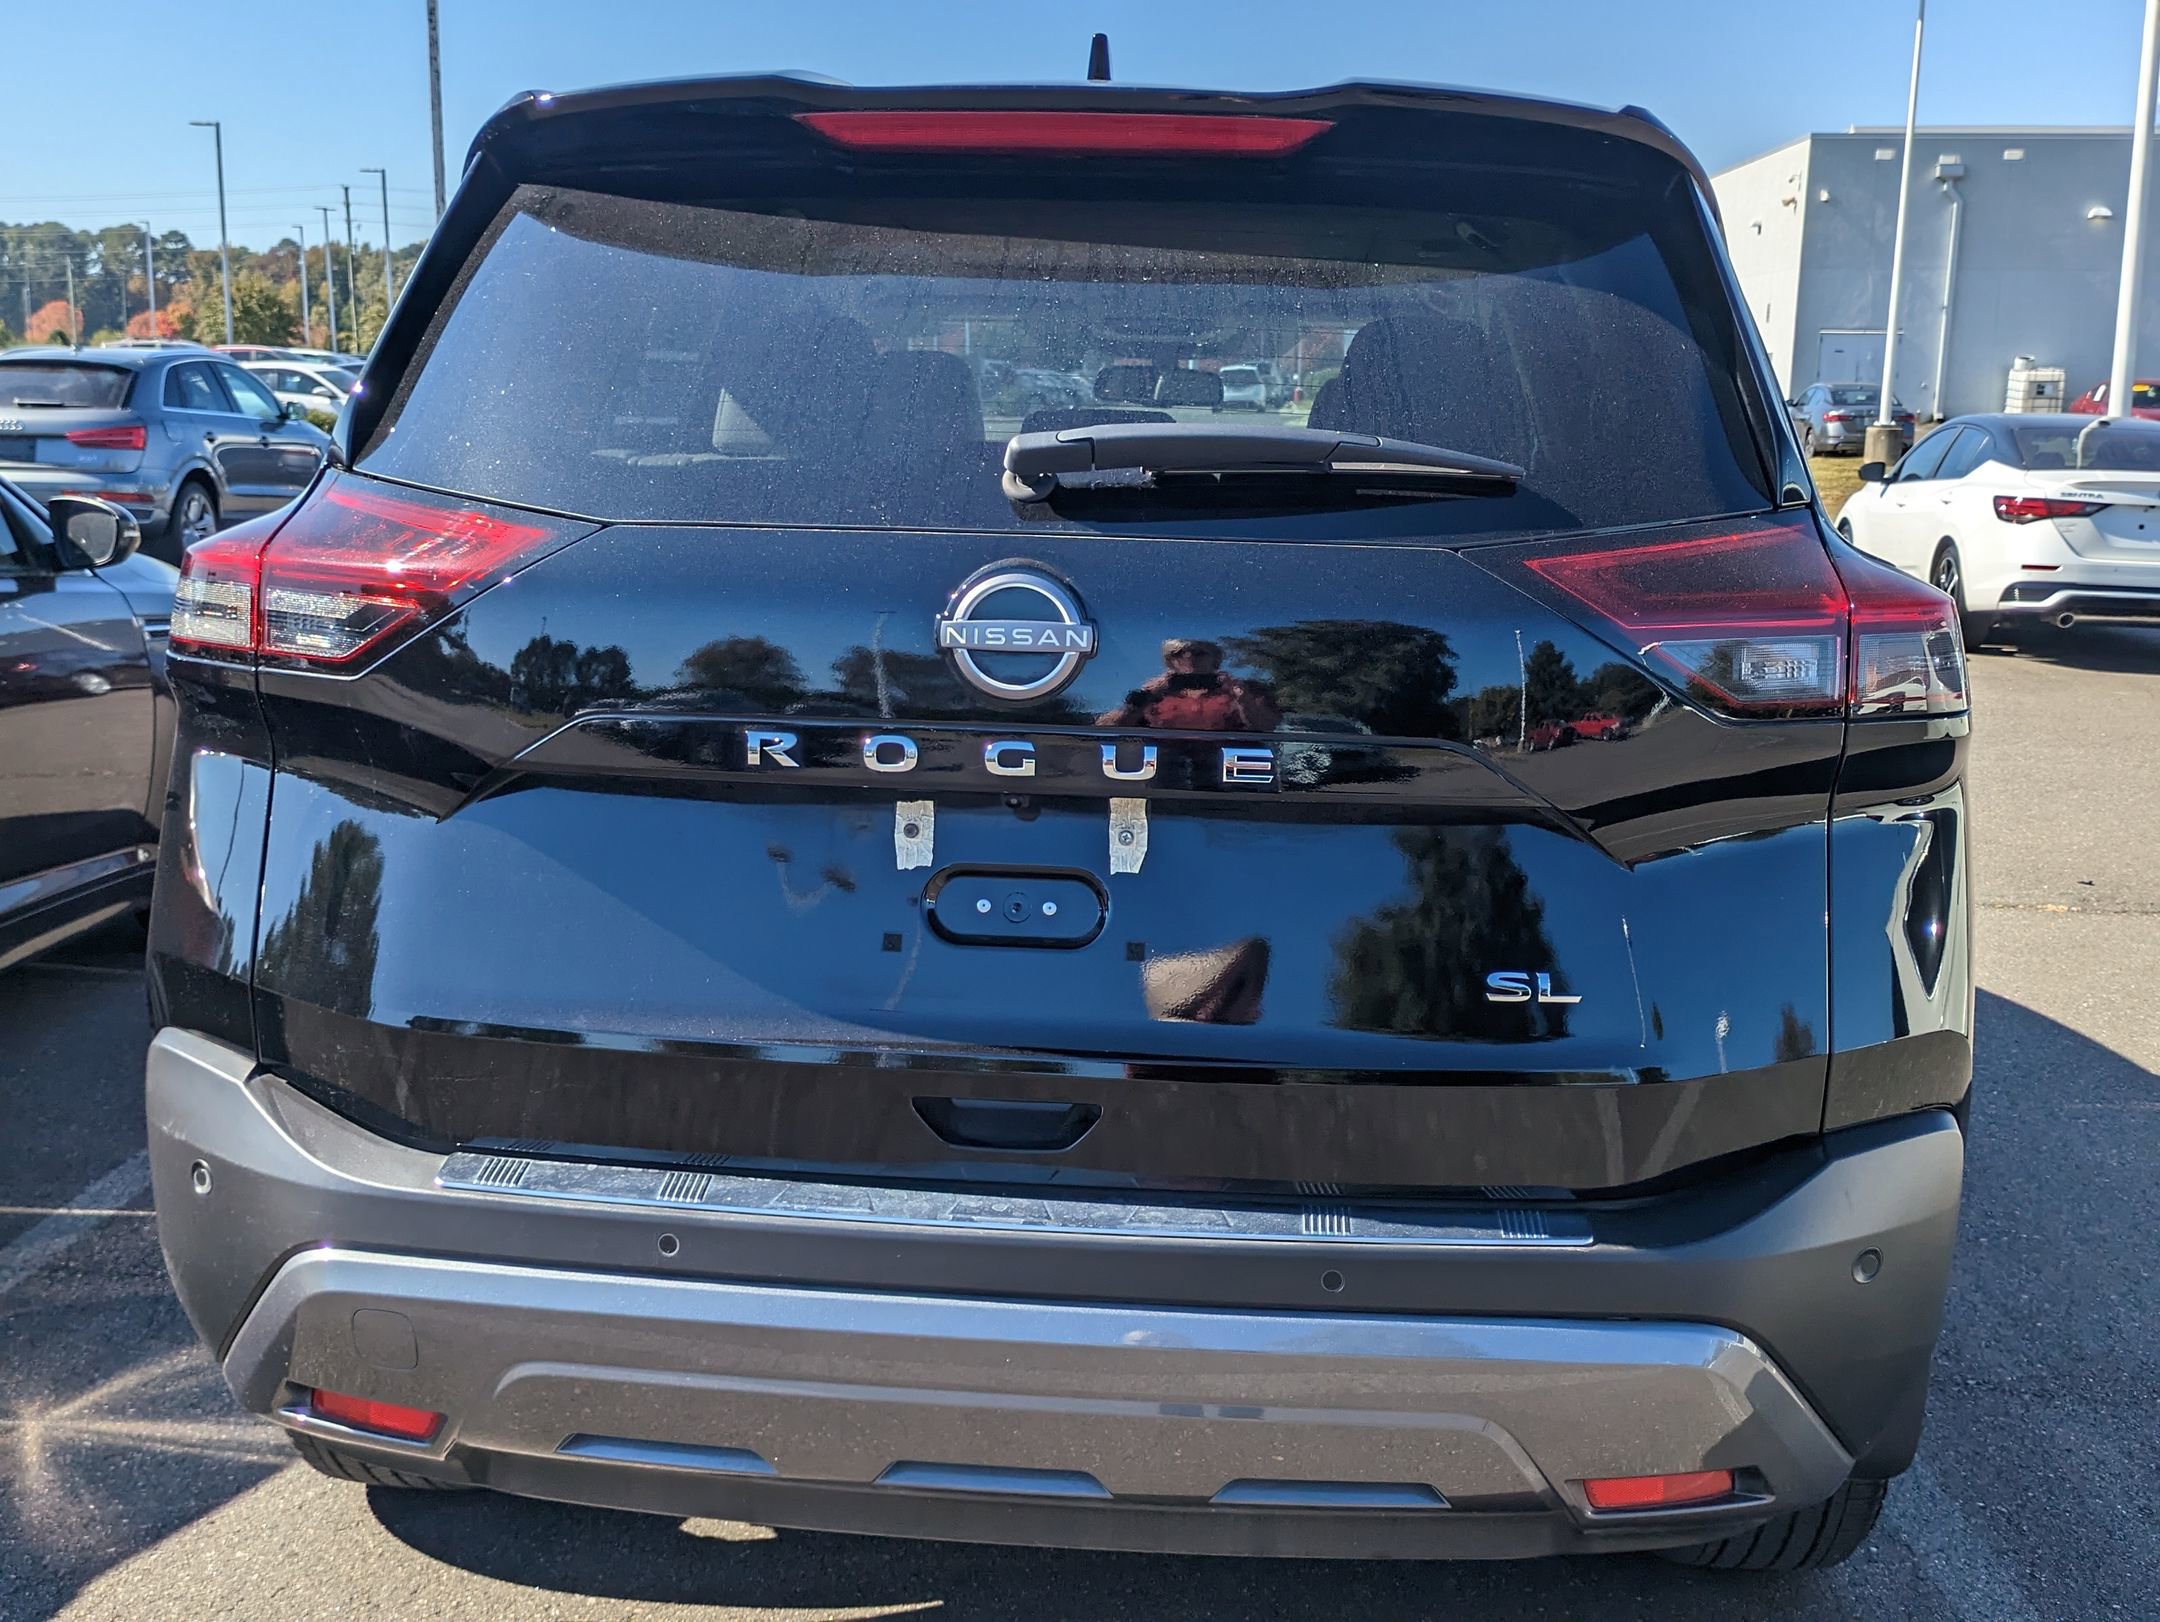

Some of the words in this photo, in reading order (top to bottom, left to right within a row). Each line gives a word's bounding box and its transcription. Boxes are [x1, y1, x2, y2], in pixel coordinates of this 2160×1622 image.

[945, 626, 1088, 648] NISSAN
[745, 730, 1275, 783] ROGUE
[1486, 971, 1582, 1003] SL
